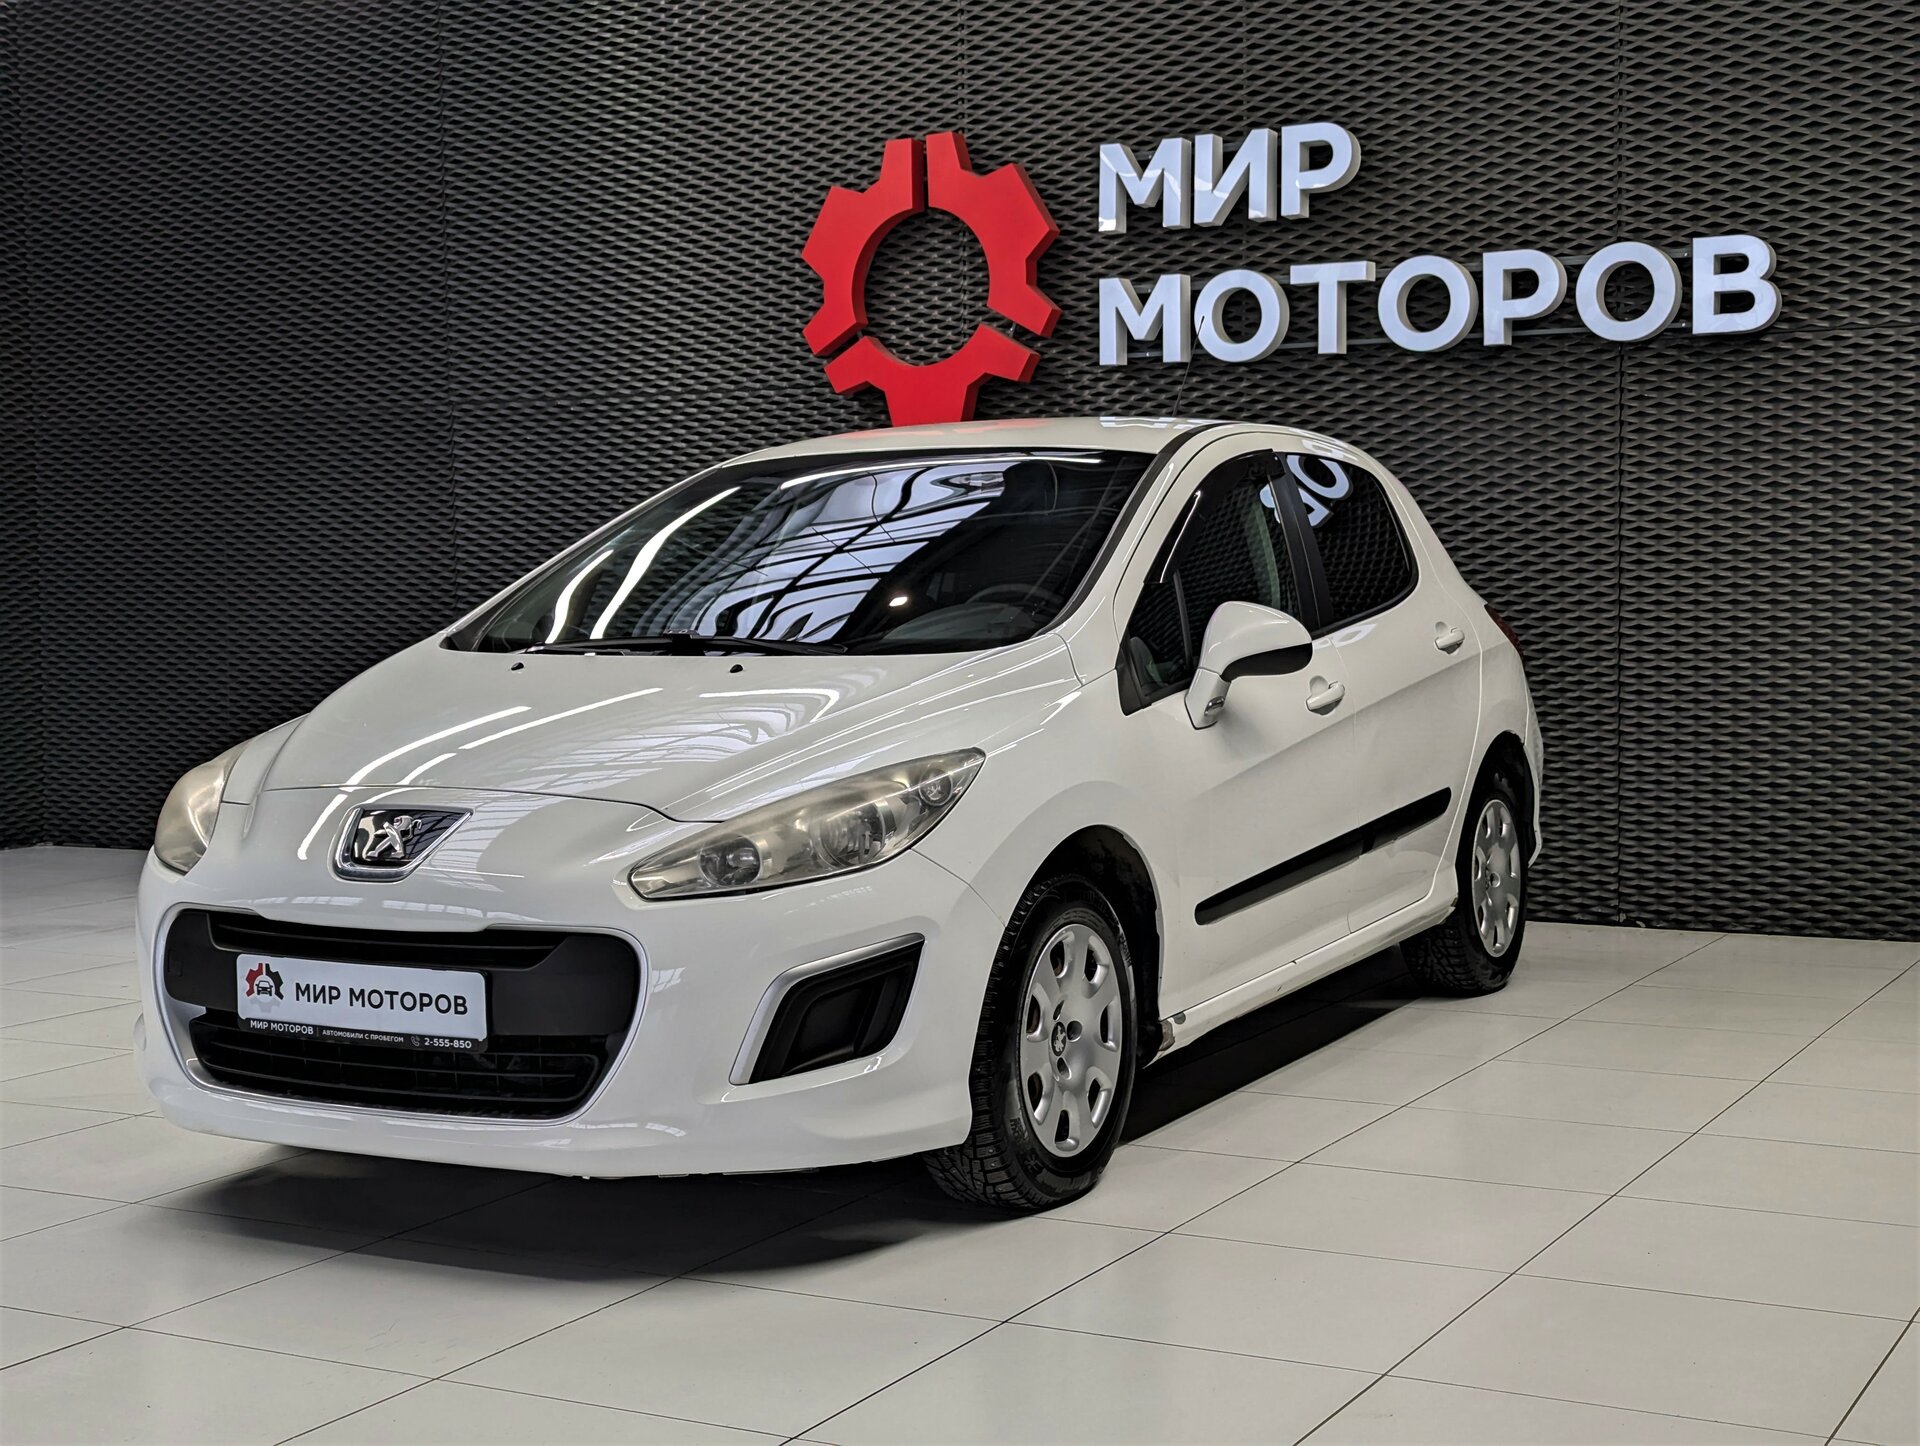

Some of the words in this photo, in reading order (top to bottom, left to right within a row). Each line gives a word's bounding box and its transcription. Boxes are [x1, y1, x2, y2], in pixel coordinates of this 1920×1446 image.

[1099, 121, 1361, 233] МИР
[1099, 234, 1783, 366] МОТОРОВ
[250, 1020, 268, 1030] МИР
[270, 1022, 314, 1035] МОТОРОВ
[322, 1029, 363, 1039] АВТОМОБИЛИ
[370, 1034, 404, 1043] ПРОБЕГОМ
[424, 1038, 472, 1049] 2-555-850
[295, 982, 341, 1005] МИР
[349, 987, 468, 1015] МОТОРОВ
